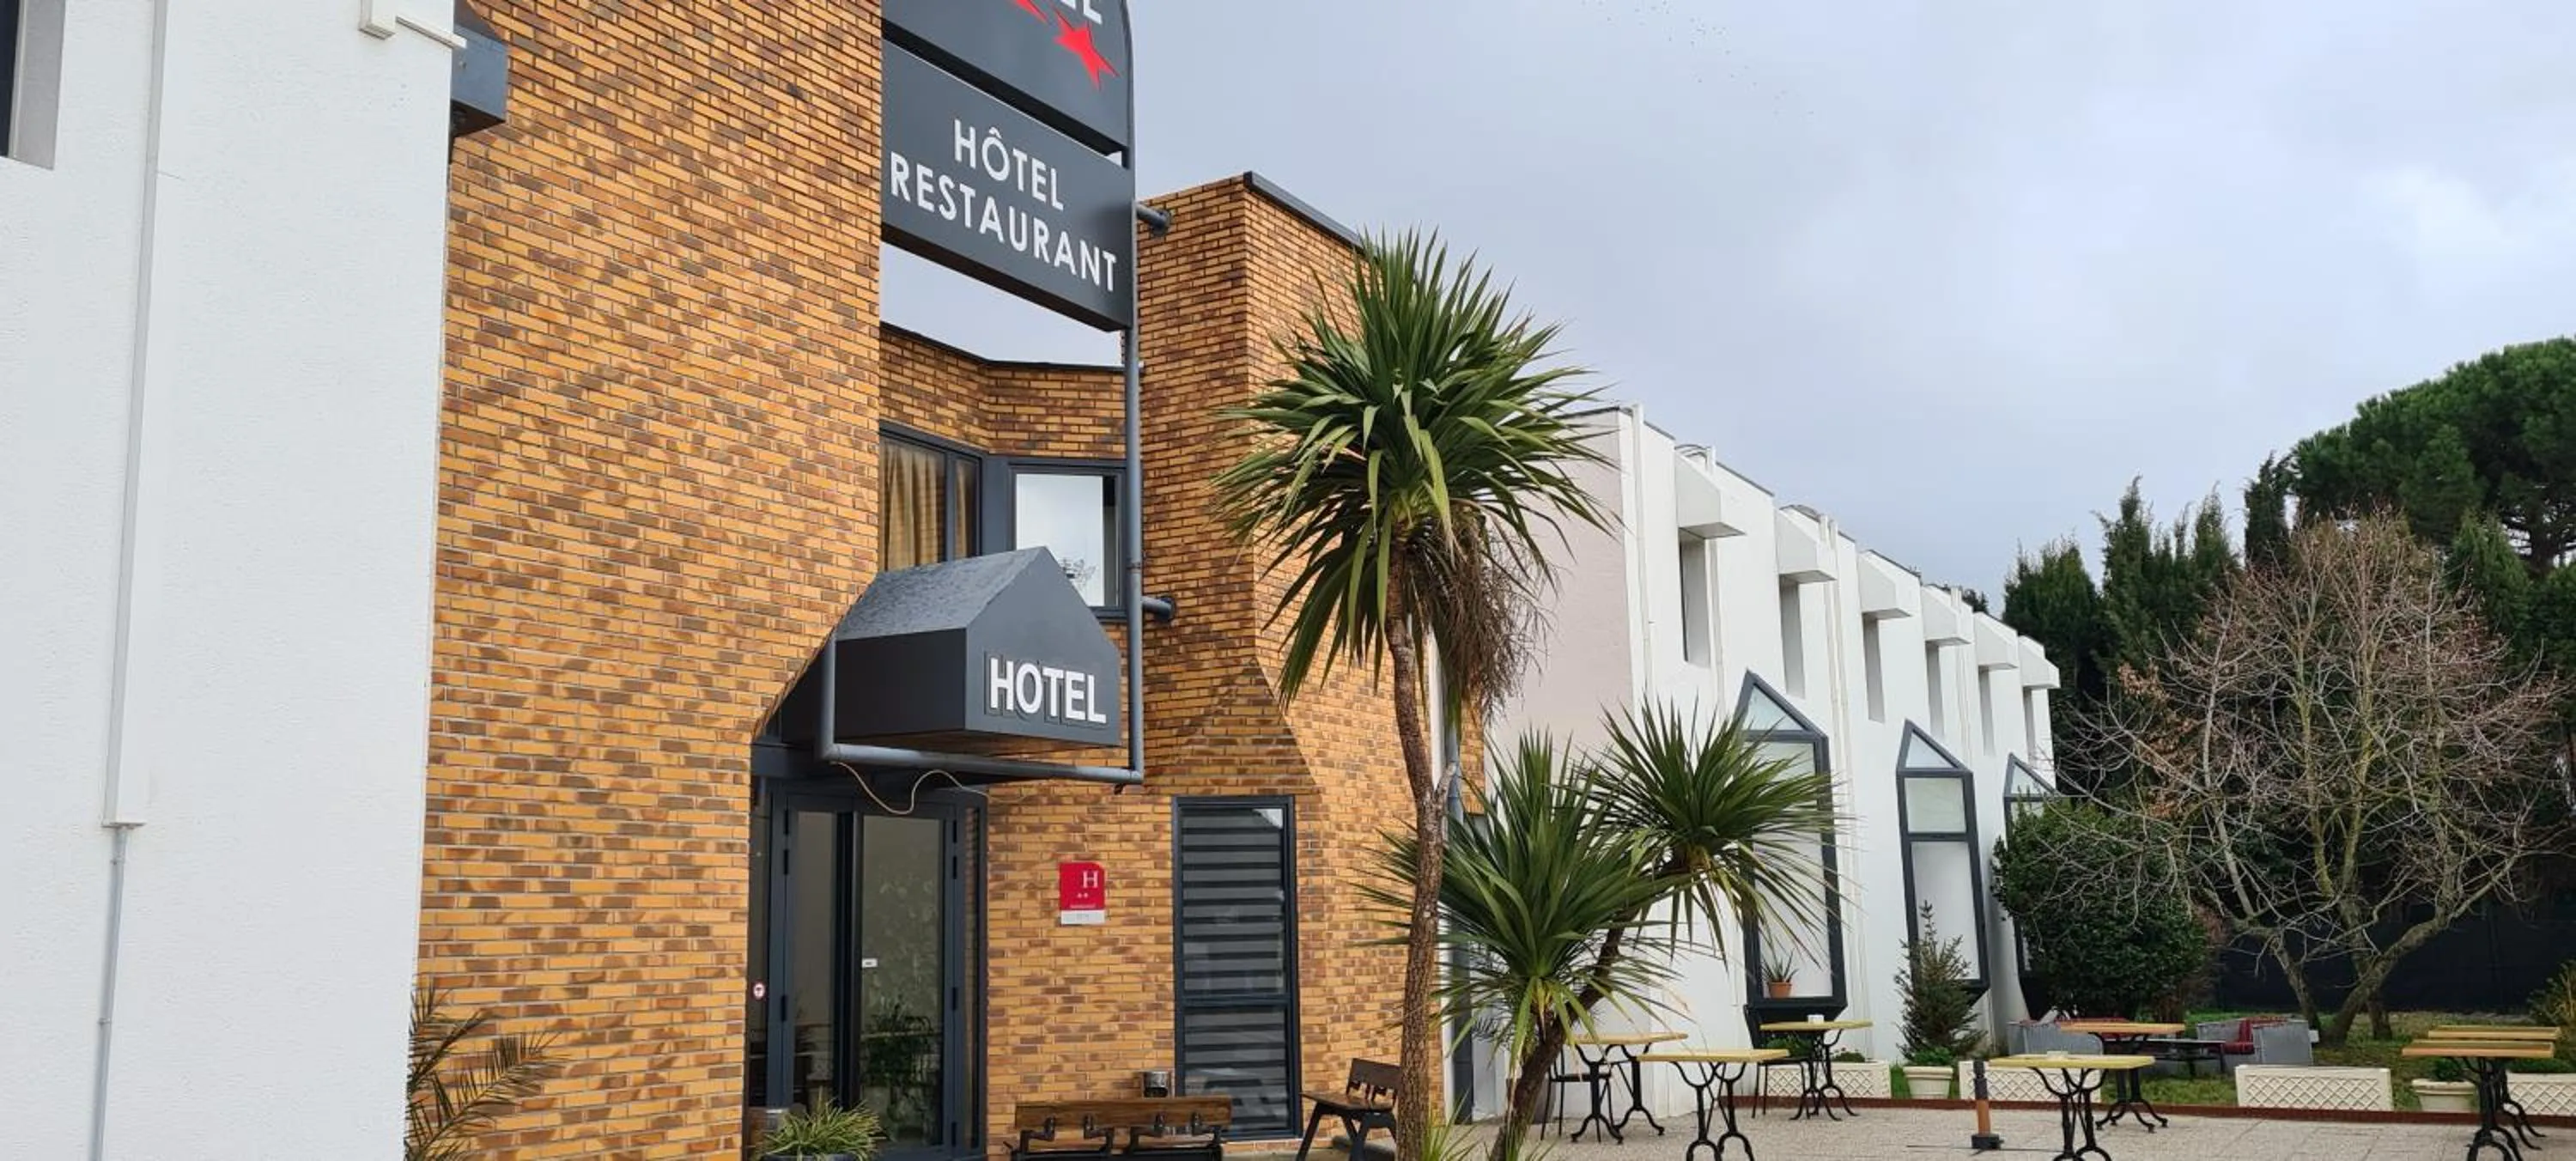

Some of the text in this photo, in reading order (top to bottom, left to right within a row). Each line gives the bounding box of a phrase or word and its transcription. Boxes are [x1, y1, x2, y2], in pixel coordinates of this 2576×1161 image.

[954, 119, 1064, 211] HÔTEL
[890, 150, 1117, 292] RESTAURANT
[990, 657, 1107, 724] HOTEL
[1083, 870, 1098, 889] H
